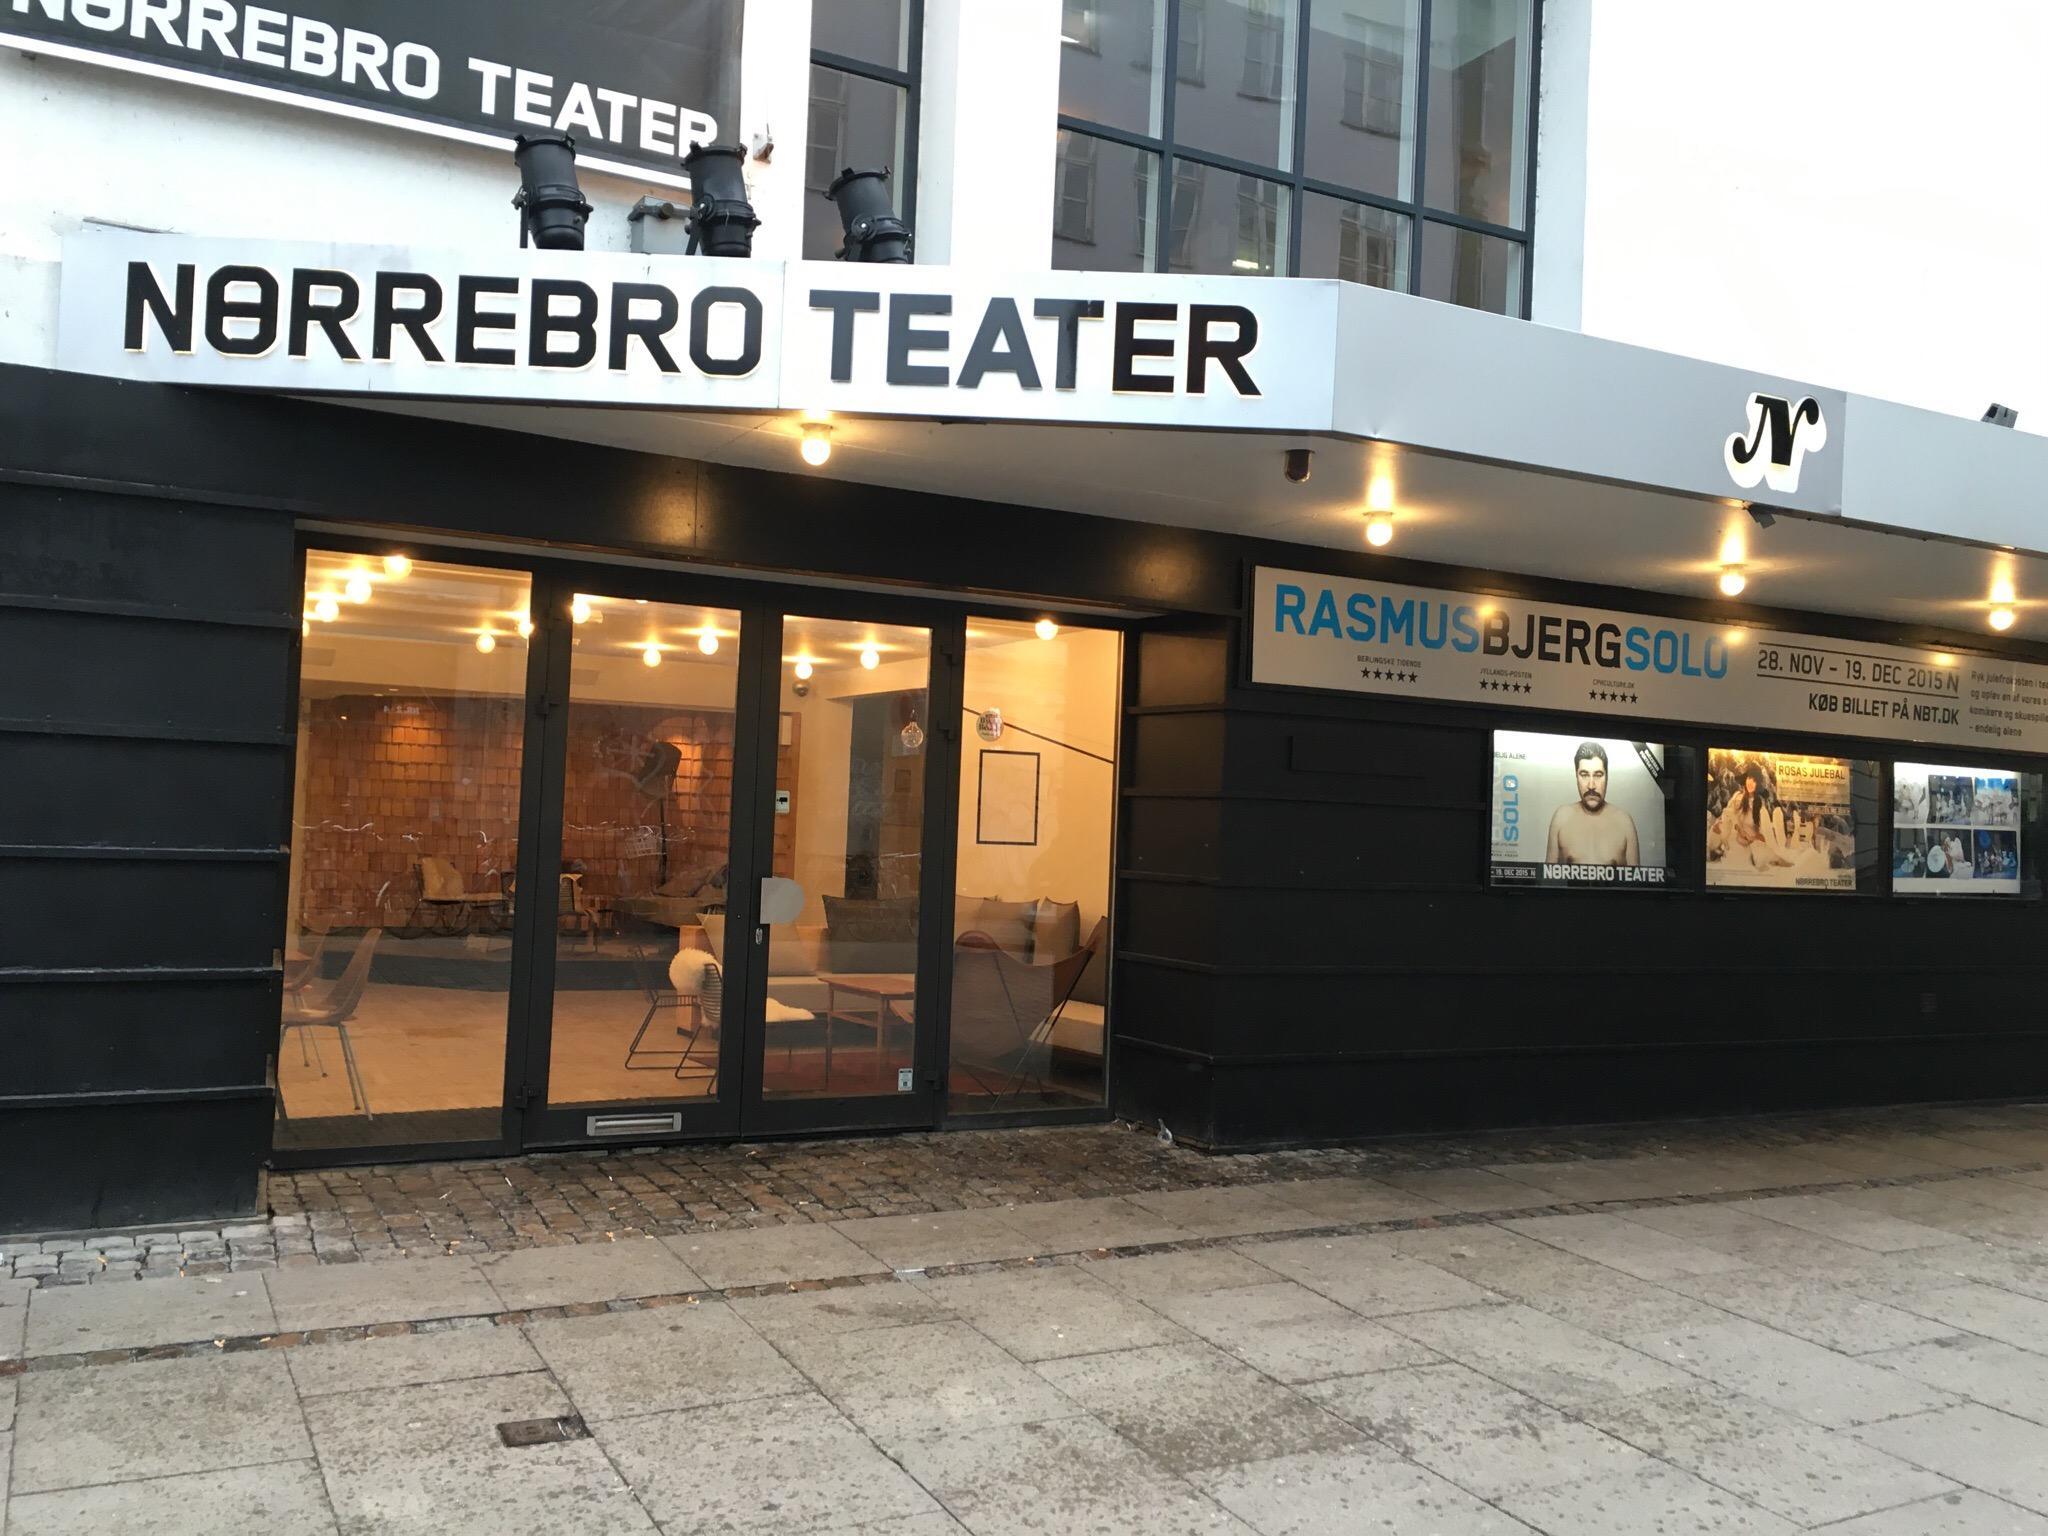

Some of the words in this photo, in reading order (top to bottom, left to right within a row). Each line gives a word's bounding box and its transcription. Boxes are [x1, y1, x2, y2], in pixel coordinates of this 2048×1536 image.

[468, 57, 718, 158] TEATER
[124, 261, 763, 378] NØRREBRO
[809, 289, 1262, 396] TEATER
[1757, 649, 1784, 671] 28.
[1789, 652, 1824, 675] NOV
[1845, 659, 1866, 681] 19.
[1872, 663, 1901, 685] DEC
[1907, 667, 1942, 689] 2015
[1808, 692, 1838, 713] KØB
[1842, 696, 1888, 718] BILLET
[1892, 697, 1910, 720] PÅ
[1913, 704, 1959, 725] NBT.DK
[1779, 764, 1808, 777] ROSAS
[1503, 774, 1520, 842] SOLO
[1543, 864, 1614, 881] NØRREBRO
[1616, 866, 1665, 883] TEATER
